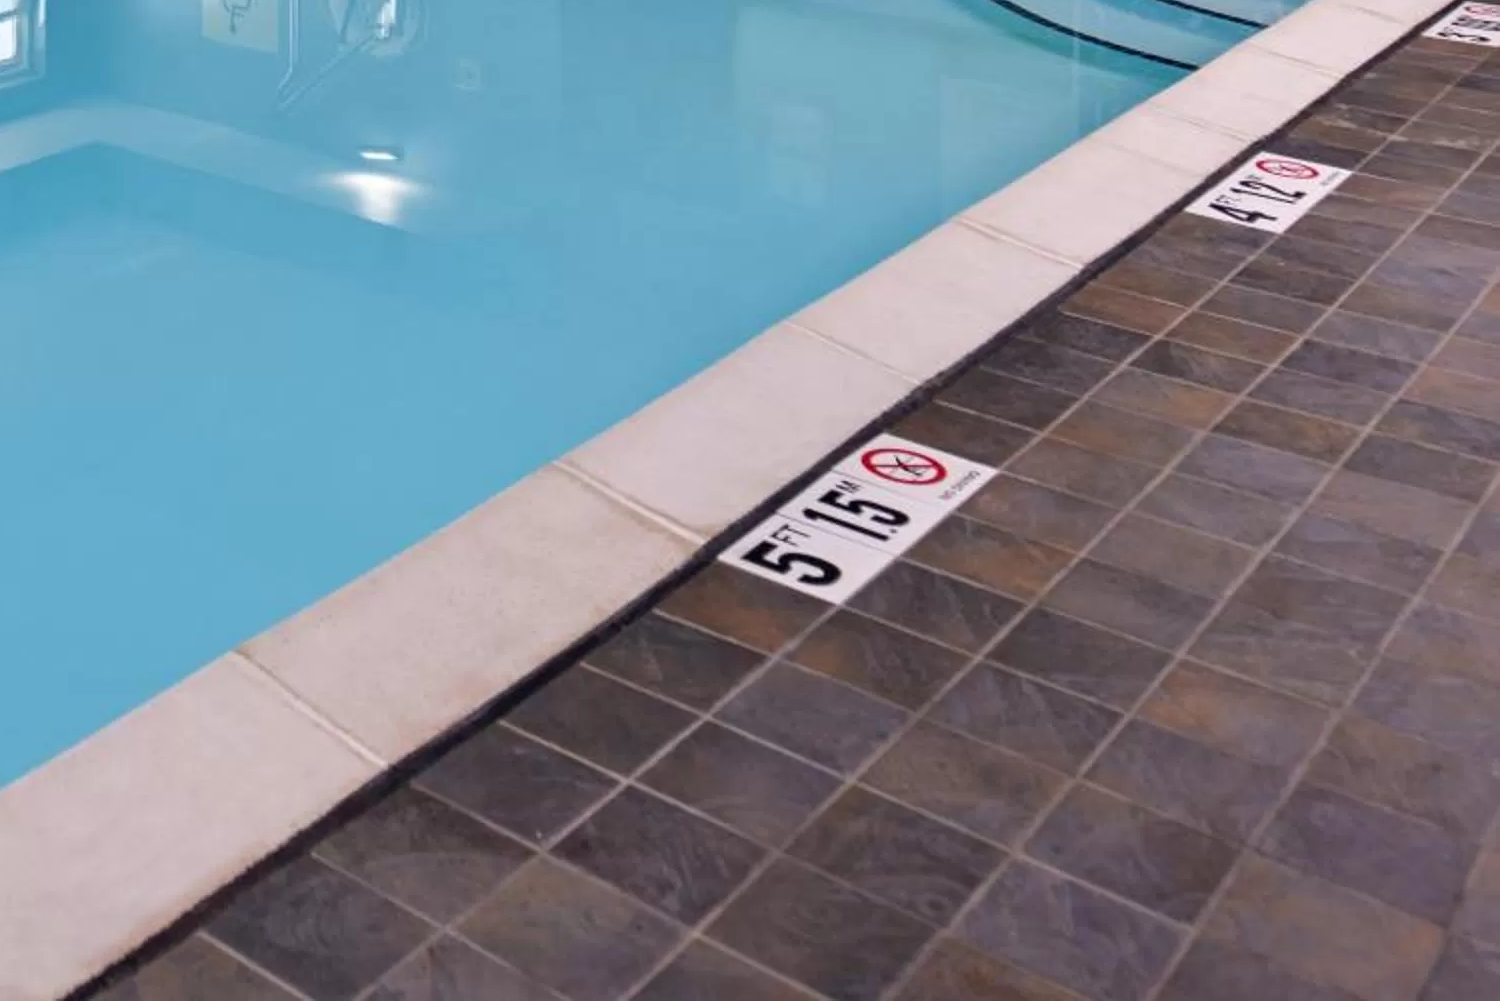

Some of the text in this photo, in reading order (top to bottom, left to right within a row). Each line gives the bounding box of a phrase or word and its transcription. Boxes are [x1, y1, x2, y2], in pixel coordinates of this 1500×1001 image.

[1208, 202, 1278, 223] 4
[769, 523, 812, 548] FT
[739, 539, 842, 587] 5
